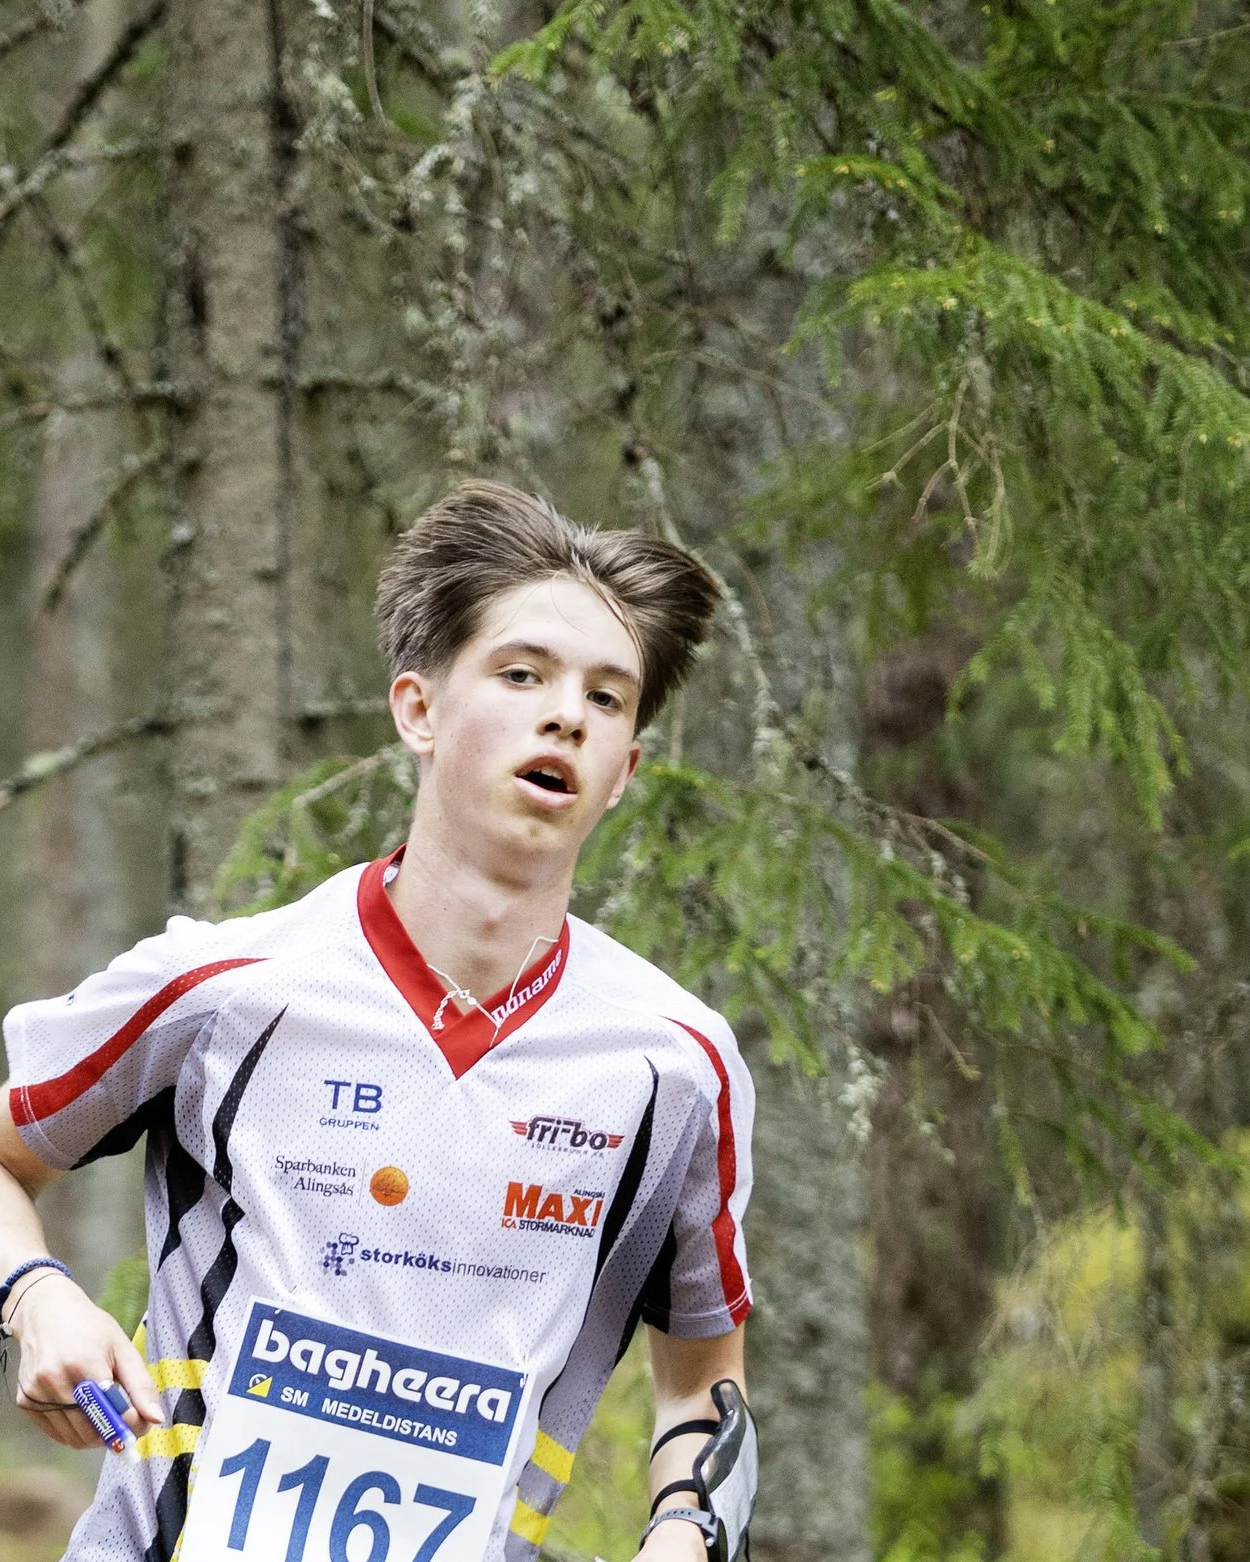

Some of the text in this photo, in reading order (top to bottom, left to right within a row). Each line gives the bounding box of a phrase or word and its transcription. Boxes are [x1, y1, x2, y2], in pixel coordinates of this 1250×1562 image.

[491, 949, 562, 1022] noname
[324, 1080, 383, 1113] TB
[319, 1117, 380, 1131] GRUPPEN
[527, 1116, 607, 1150] fri-bo
[275, 1155, 356, 1177] Sparbanken
[294, 1177, 354, 1197] Alingsås
[503, 1181, 604, 1227] MAXI
[501, 1218, 595, 1238] ICA STORMARKNAD
[251, 1319, 512, 1423] bagheera
[280, 1387, 458, 1447] SM MEDELDISTANS
